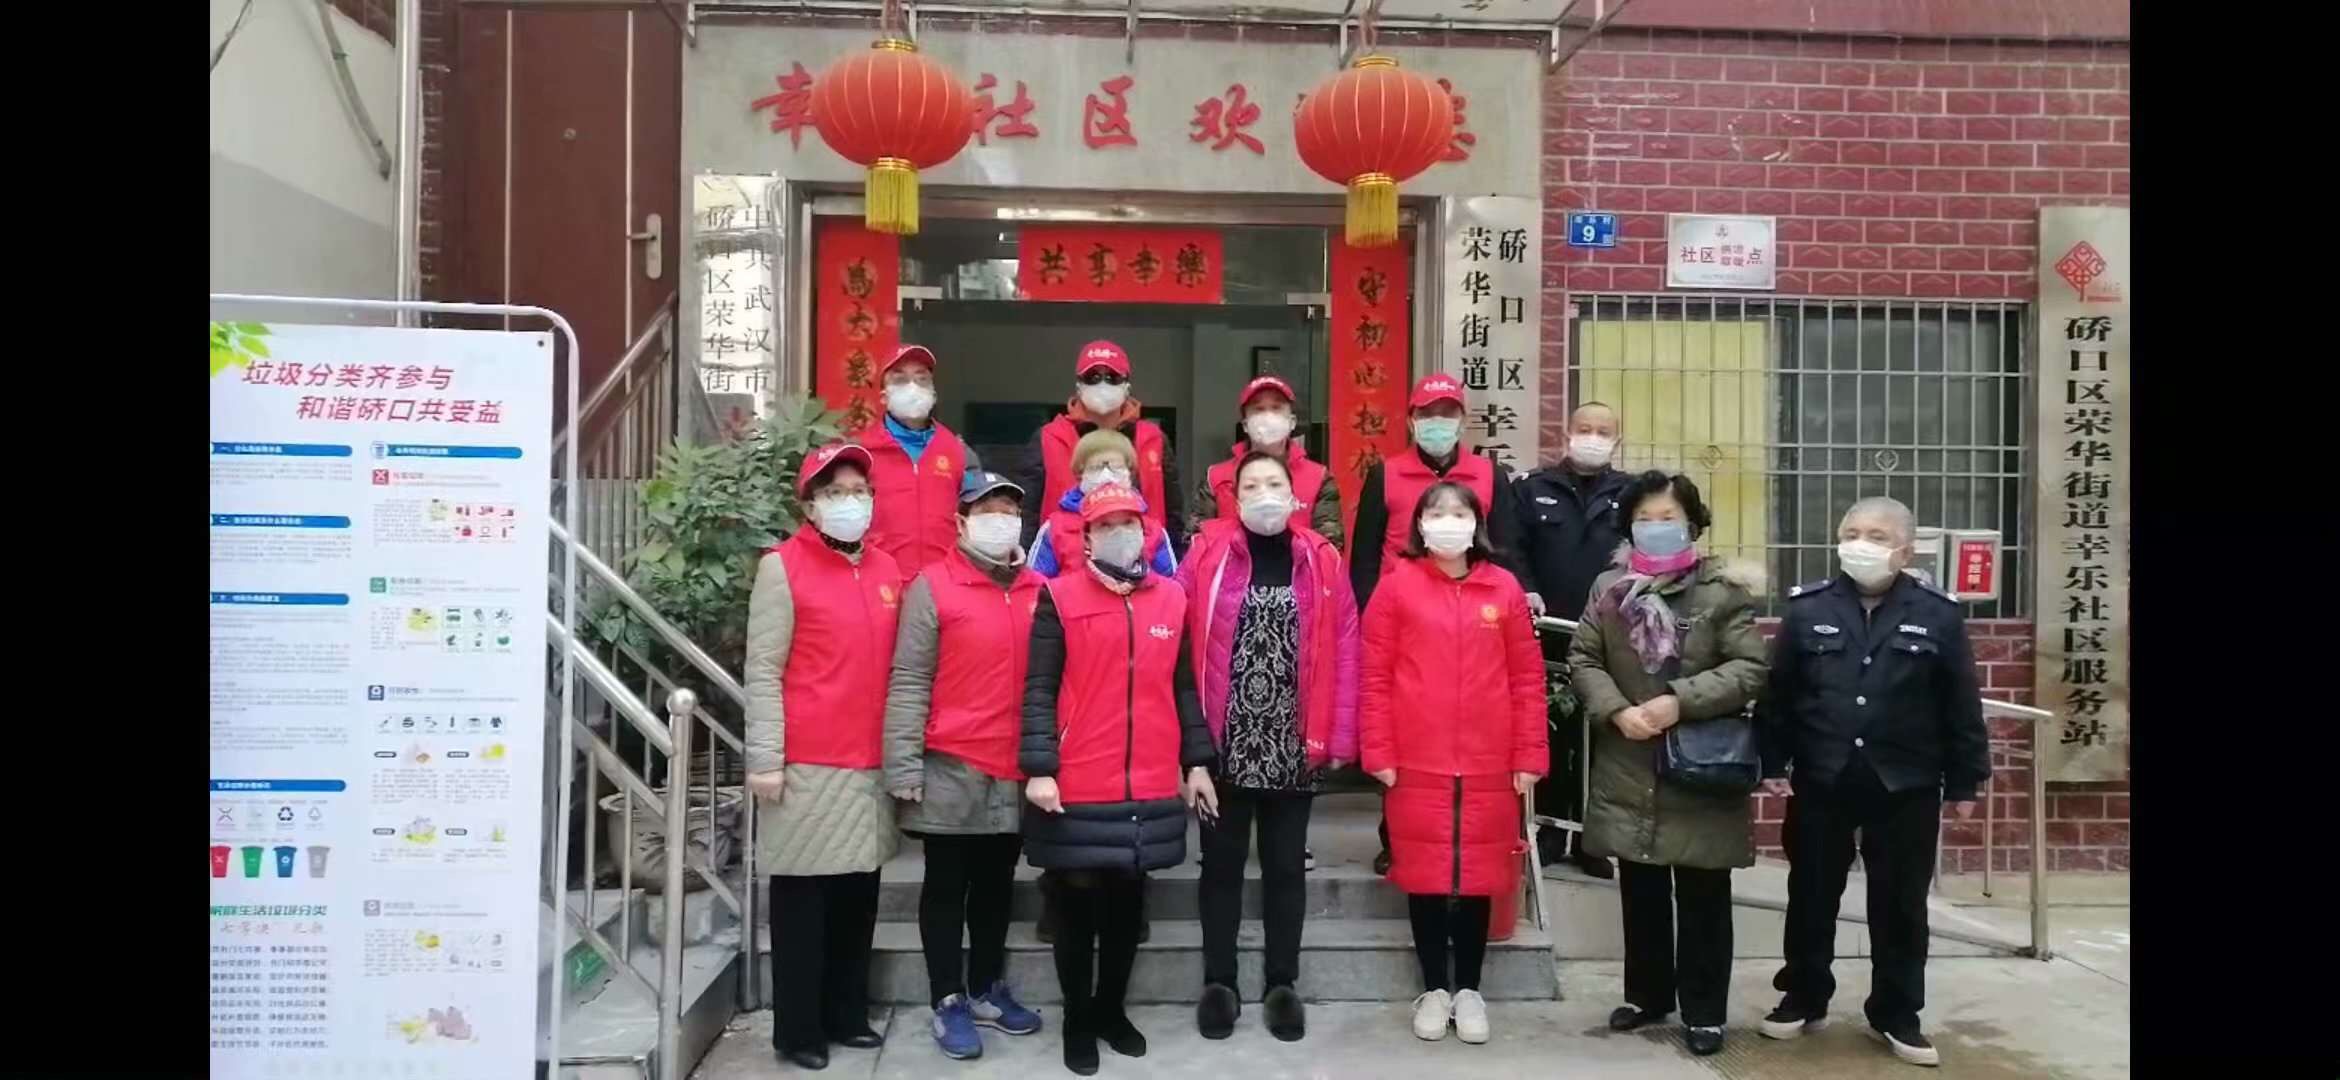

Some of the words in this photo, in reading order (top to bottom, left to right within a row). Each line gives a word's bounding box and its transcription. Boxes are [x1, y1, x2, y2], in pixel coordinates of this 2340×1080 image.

[1582, 225, 1596, 242] 9
[1681, 246, 1716, 264] 社区
[1746, 248, 1763, 265] 点
[1460, 227, 1491, 391] 荣华街道
[1499, 229, 1527, 391] 硚口区
[242, 361, 454, 390] 垃圾分类齐参与
[296, 396, 503, 424] 和谐硚口共受益
[2061, 316, 2113, 747] 硚口区荣华街道幸乐社区服务站
